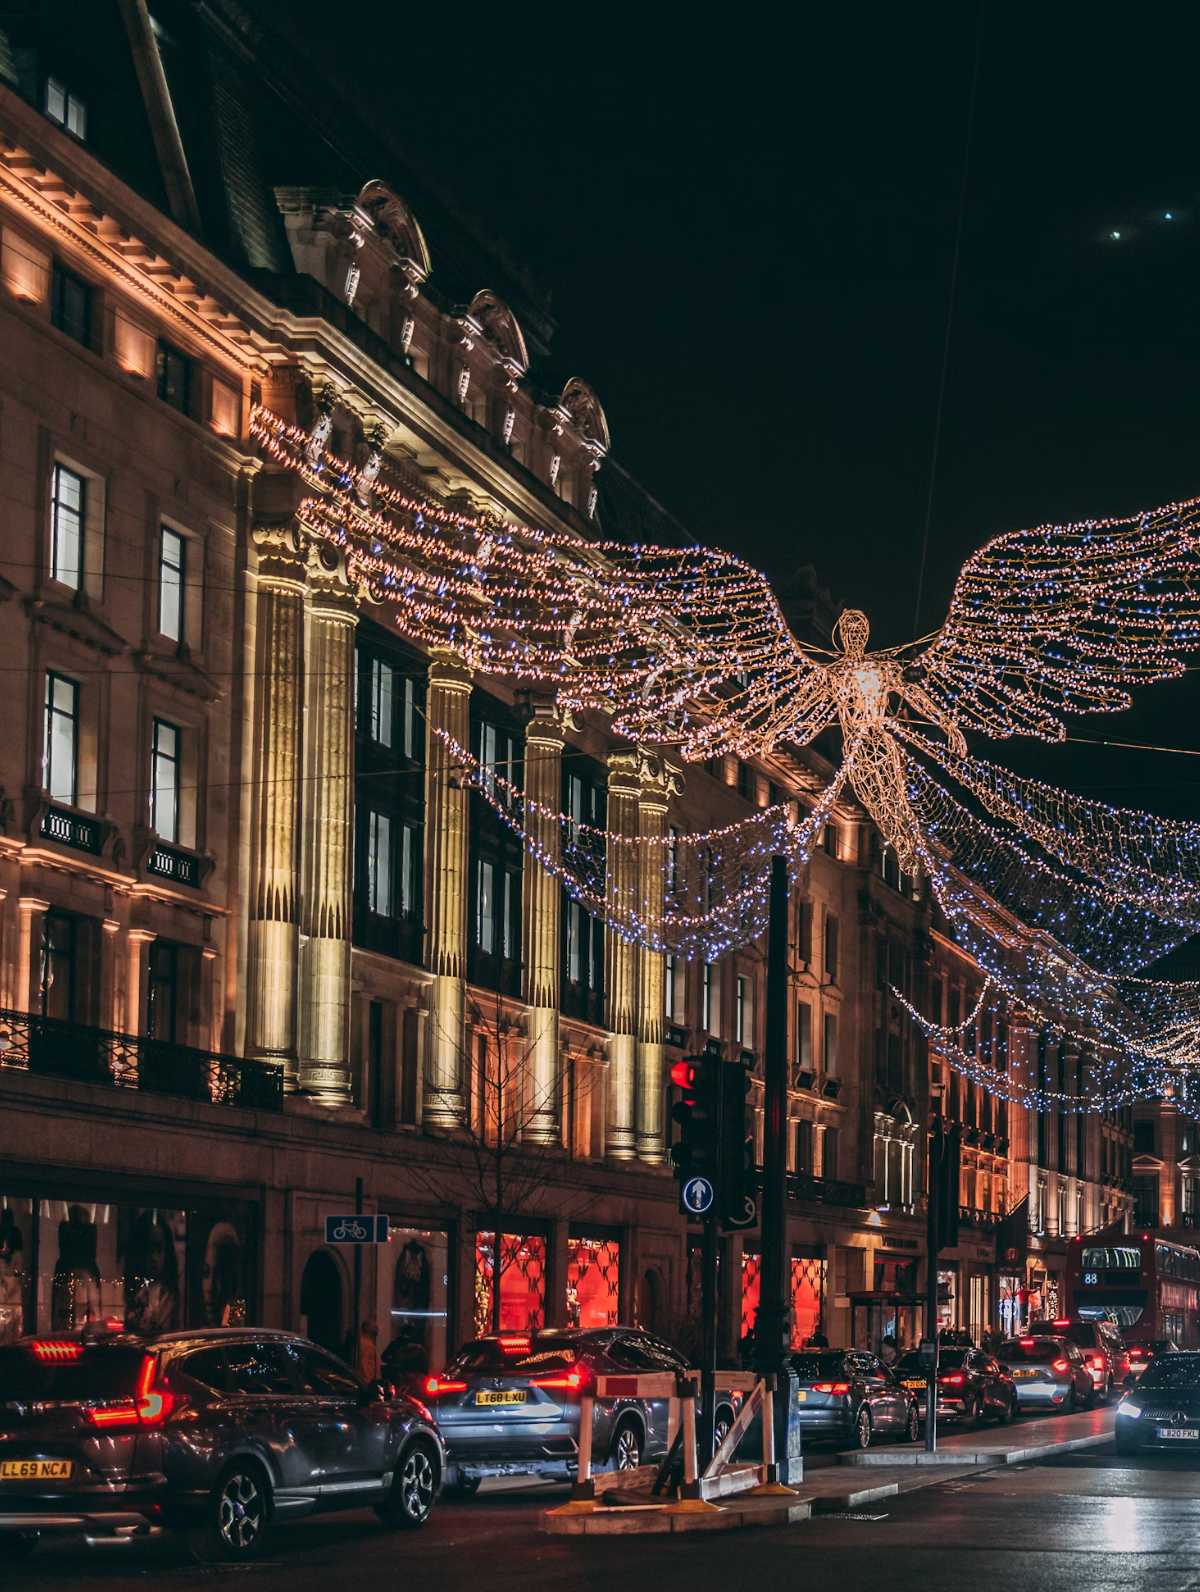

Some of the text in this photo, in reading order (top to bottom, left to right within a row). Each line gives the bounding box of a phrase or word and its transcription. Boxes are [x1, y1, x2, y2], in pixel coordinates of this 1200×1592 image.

[1084, 1273, 1098, 1284] 88
[477, 1392, 525, 1404] LT68 LXU
[1161, 1430, 1198, 1438] LB20 FKL
[2, 1462, 67, 1477] LL69 NCA
